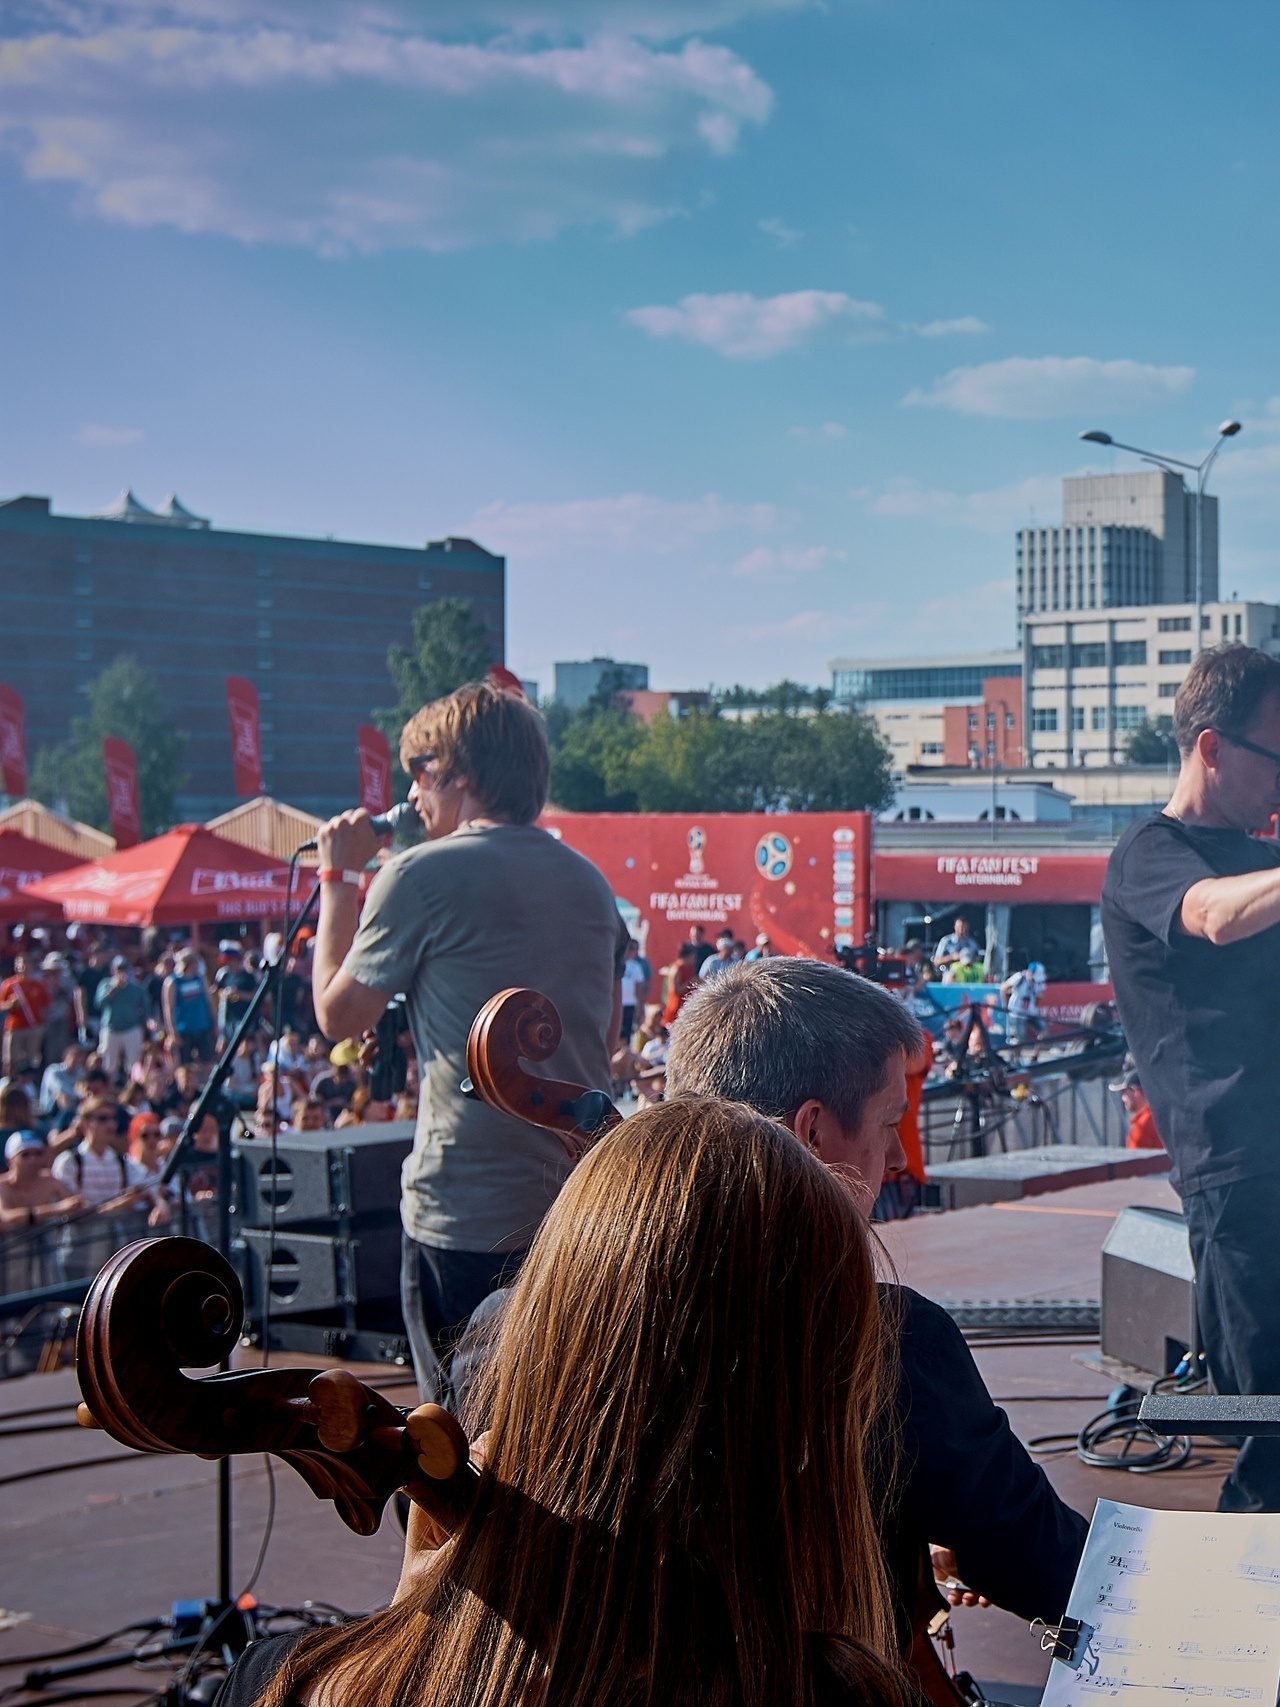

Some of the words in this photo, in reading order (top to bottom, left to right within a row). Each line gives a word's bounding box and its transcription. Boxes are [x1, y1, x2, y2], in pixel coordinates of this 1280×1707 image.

[937, 856, 970, 874] FIFA
[970, 856, 1002, 874] FAN
[1003, 857, 1040, 875] FEST
[213, 870, 276, 891] Bud
[954, 873, 1022, 886] EKATERINBURG
[649, 892, 680, 910] FIFA
[680, 892, 709, 910] FAN
[709, 893, 743, 911] FEST
[1113, 1521, 1143, 1532] Violoncello
